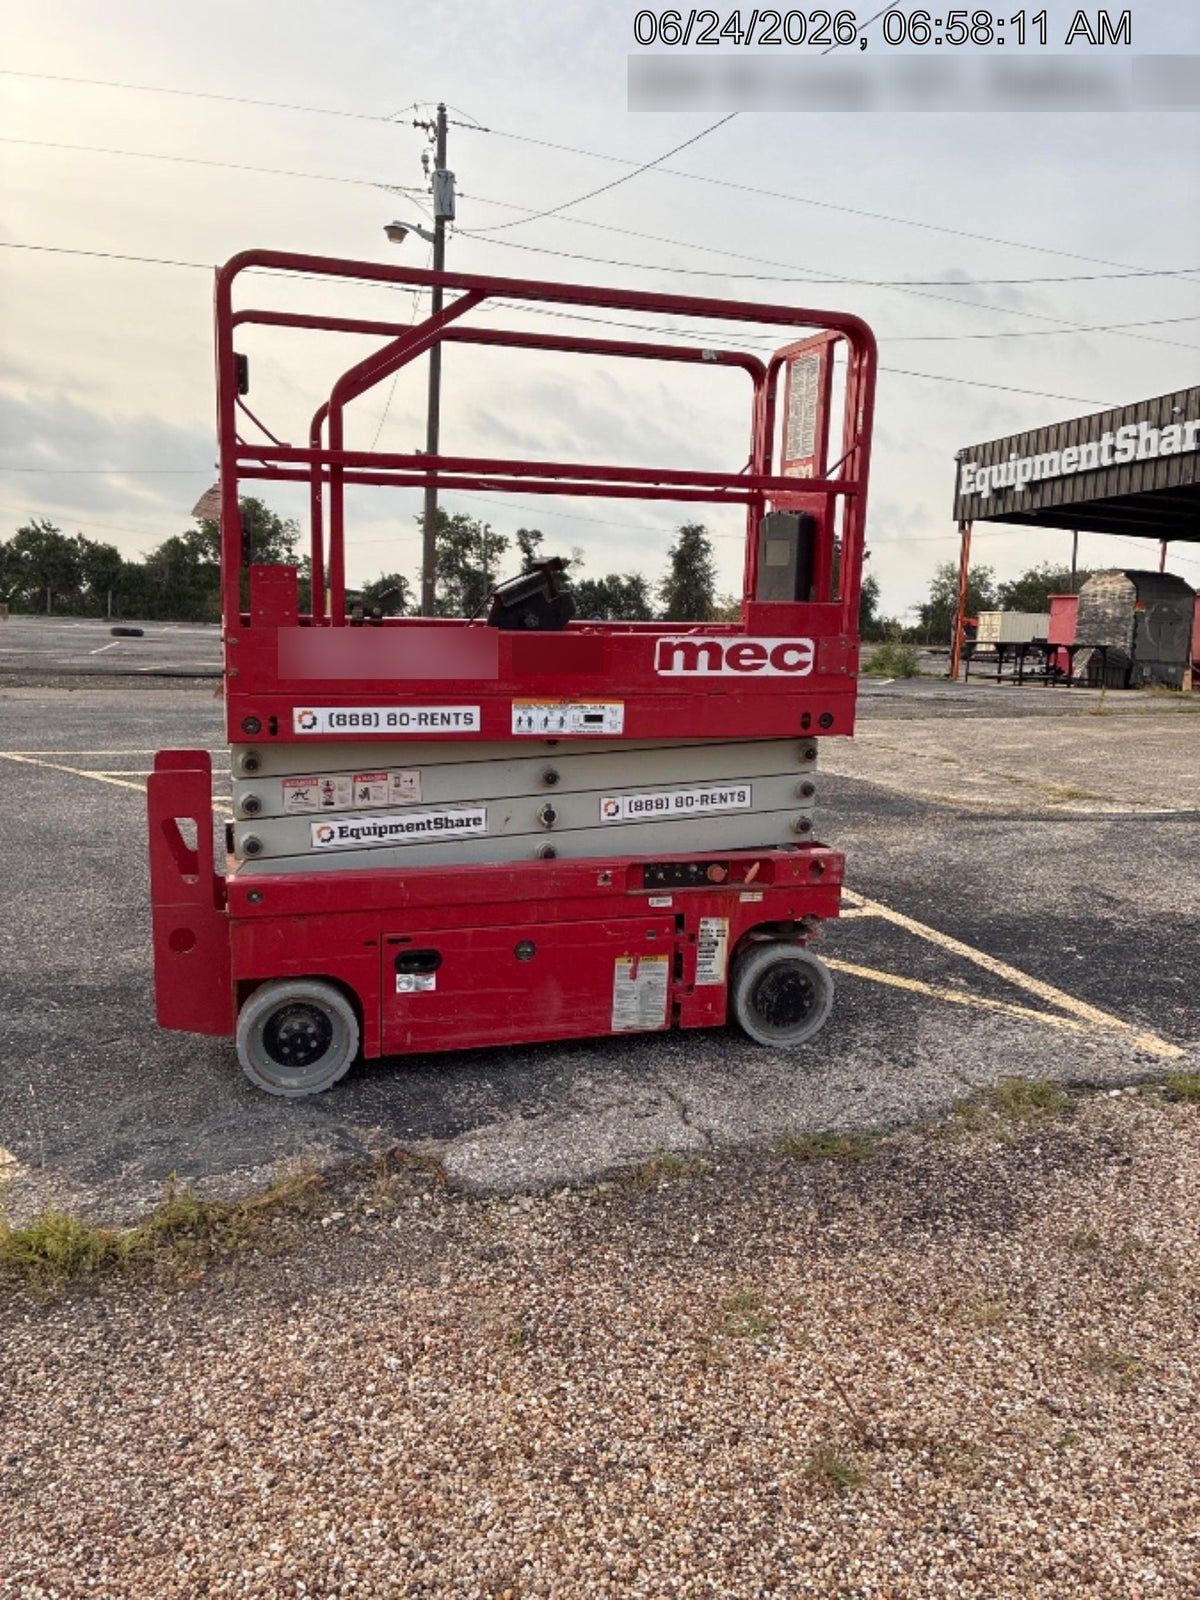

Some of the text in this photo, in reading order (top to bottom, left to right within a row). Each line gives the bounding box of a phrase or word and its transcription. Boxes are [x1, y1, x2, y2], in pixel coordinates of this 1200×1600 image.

[659, 641, 812, 672] mec
[328, 712, 474, 728] (888) 80-RENTS
[628, 790, 746, 813] (888) 80-RENTS
[337, 815, 483, 840] EquipmentShare
